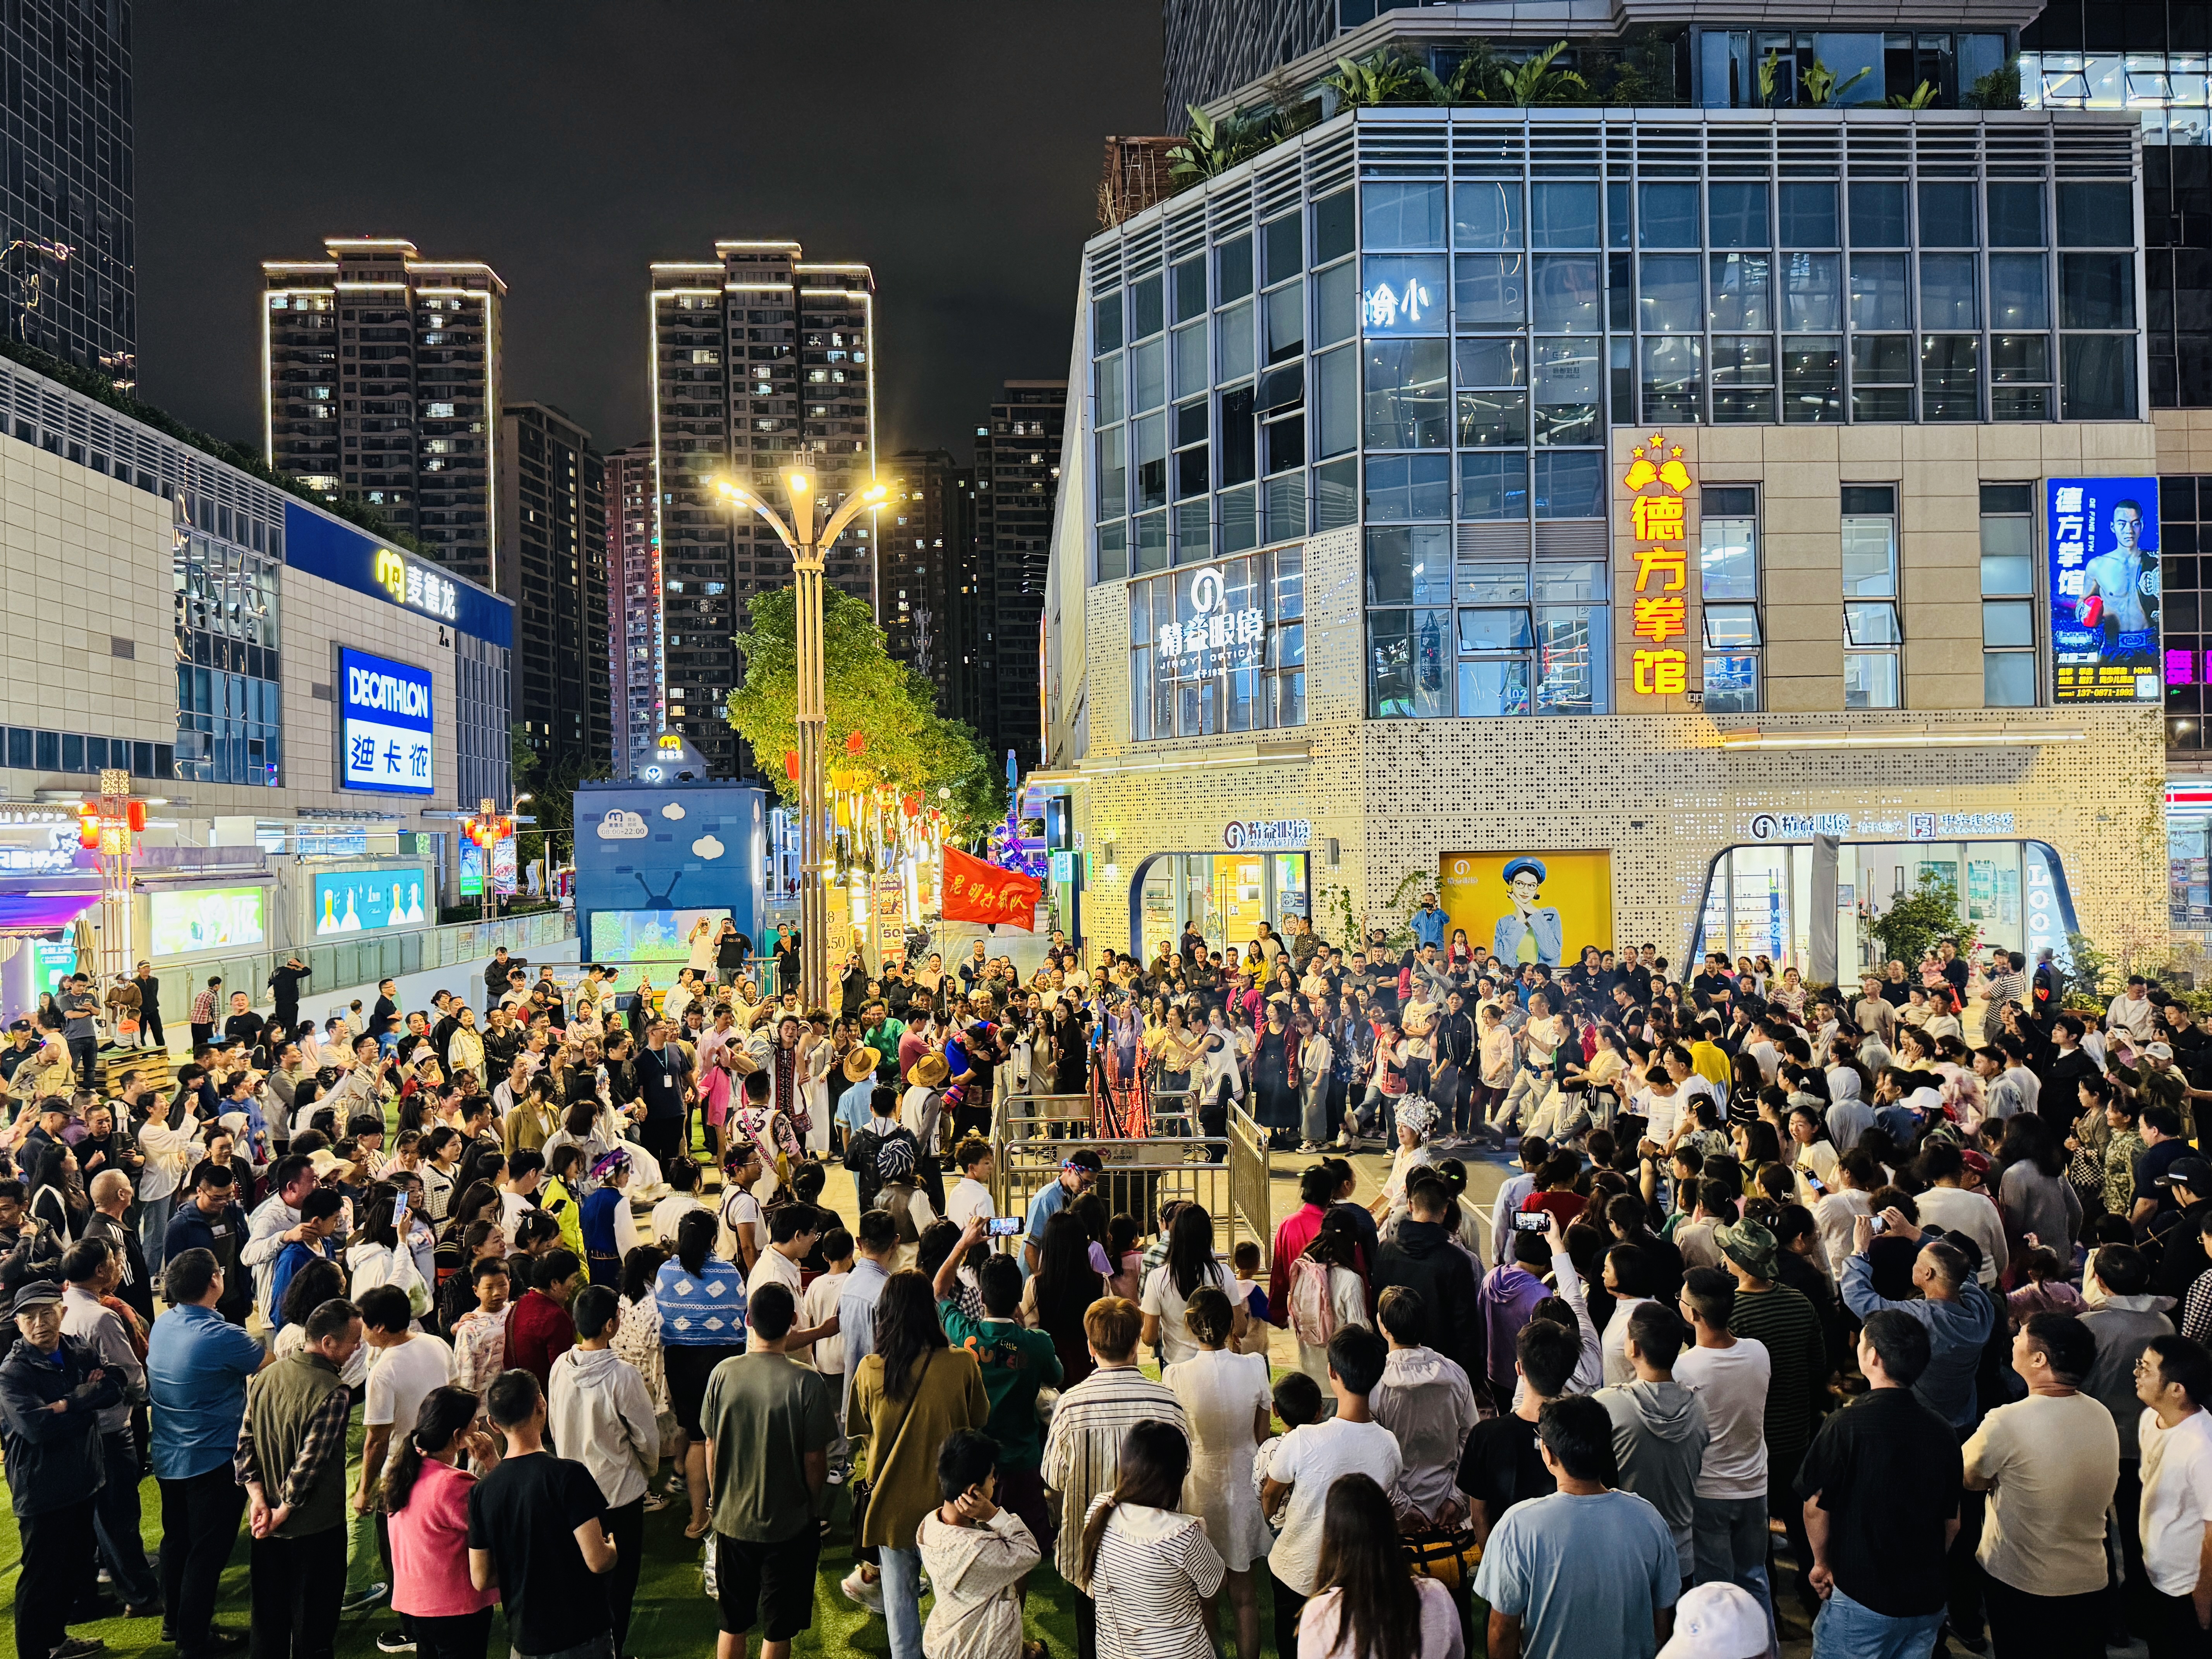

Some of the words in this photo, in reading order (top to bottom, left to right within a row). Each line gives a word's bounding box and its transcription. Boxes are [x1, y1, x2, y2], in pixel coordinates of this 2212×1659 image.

[2055, 487, 2086, 595] 德方拳馆
[407, 566, 455, 620] 麦德龙
[1631, 495, 1686, 694] 德方拳馆
[1159, 607, 1266, 658] 精益眼镜
[1210, 647, 1261, 662] OPTICAL
[349, 666, 428, 718] DECATHLON
[2076, 689, 2134, 697] 137-0871-1992
[352, 734, 428, 777] 迪卡侬
[1247, 820, 1311, 839] 精益眼镜
[1940, 812, 2014, 826] 中华老字号
[949, 874, 1029, 912] 昆明打歌队
